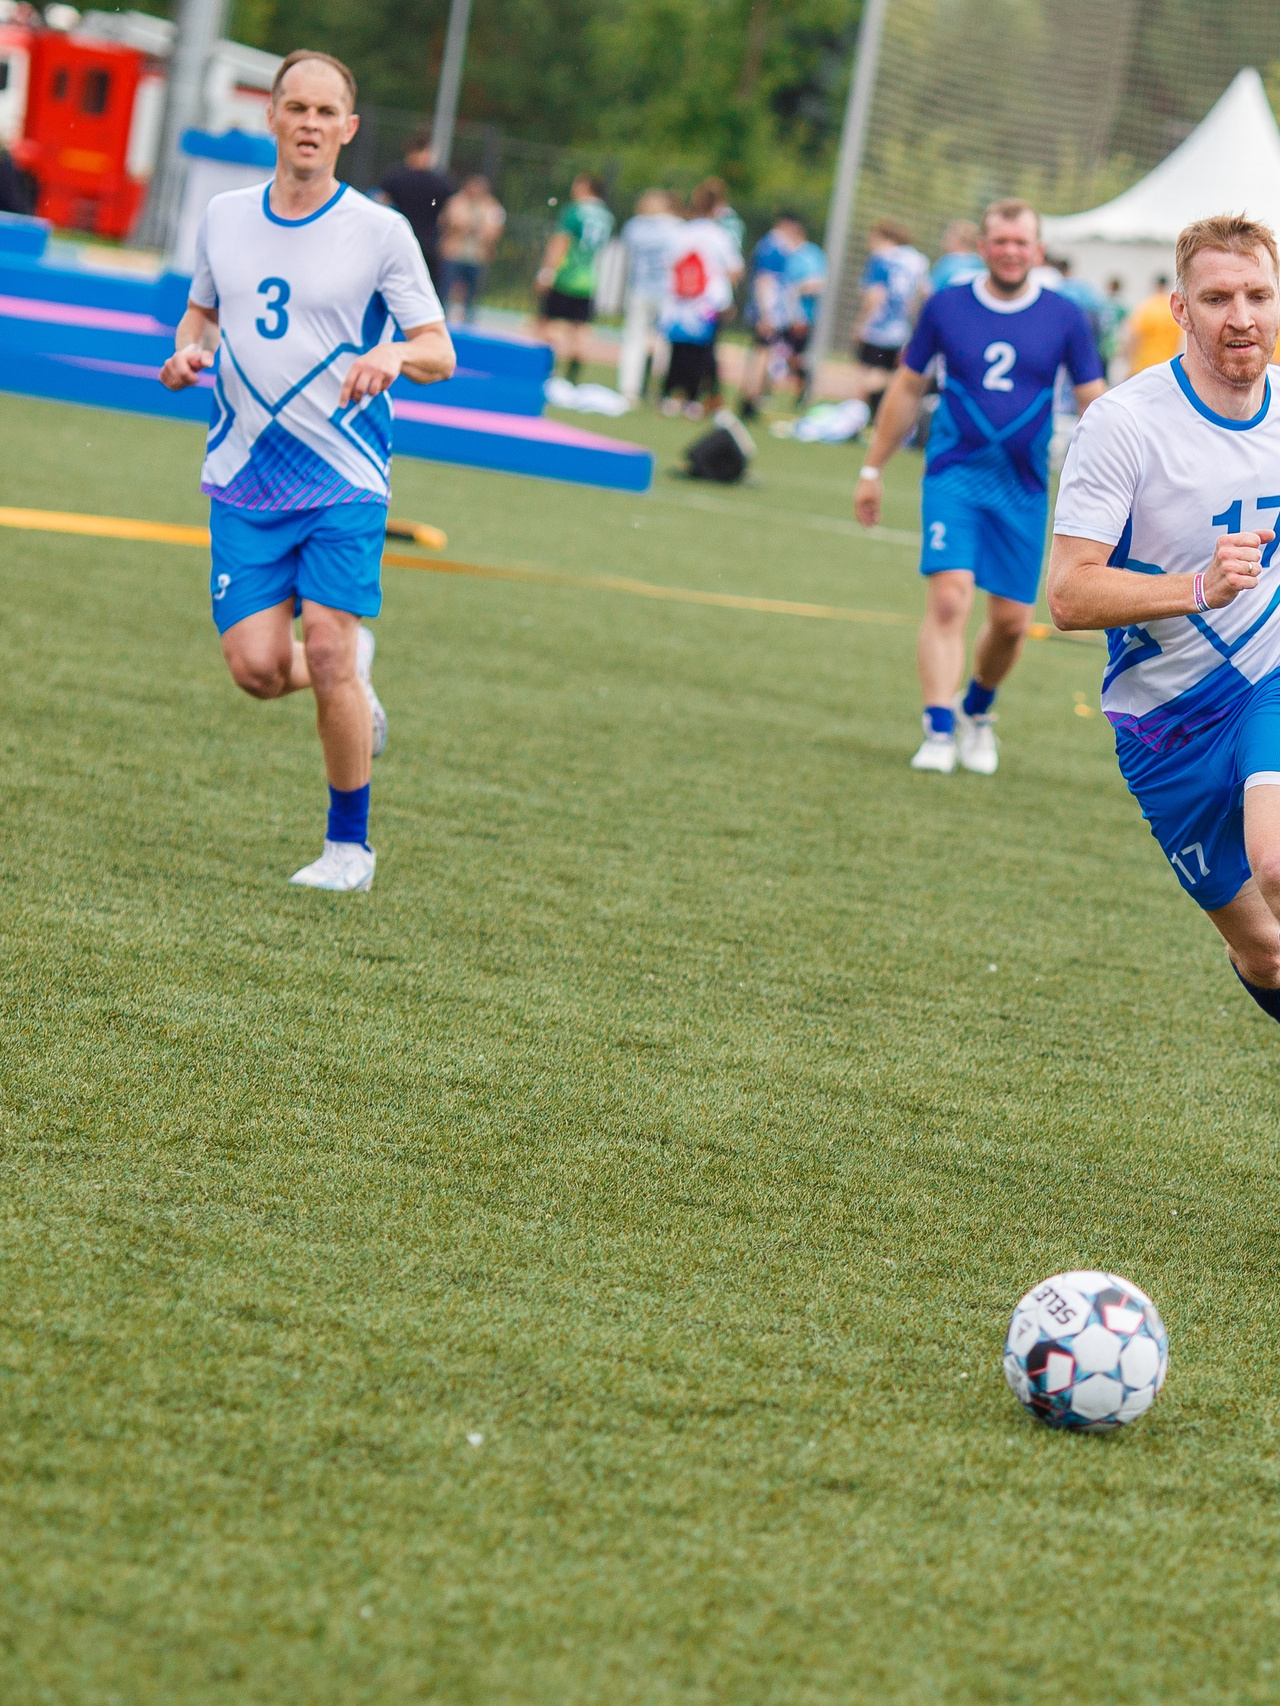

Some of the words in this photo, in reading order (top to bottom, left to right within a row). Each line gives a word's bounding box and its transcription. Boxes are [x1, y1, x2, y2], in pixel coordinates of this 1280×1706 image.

[255, 276, 291, 340] 3
[982, 341, 1017, 392] 2
[929, 521, 947, 550] 2
[1170, 842, 1210, 885] 17
